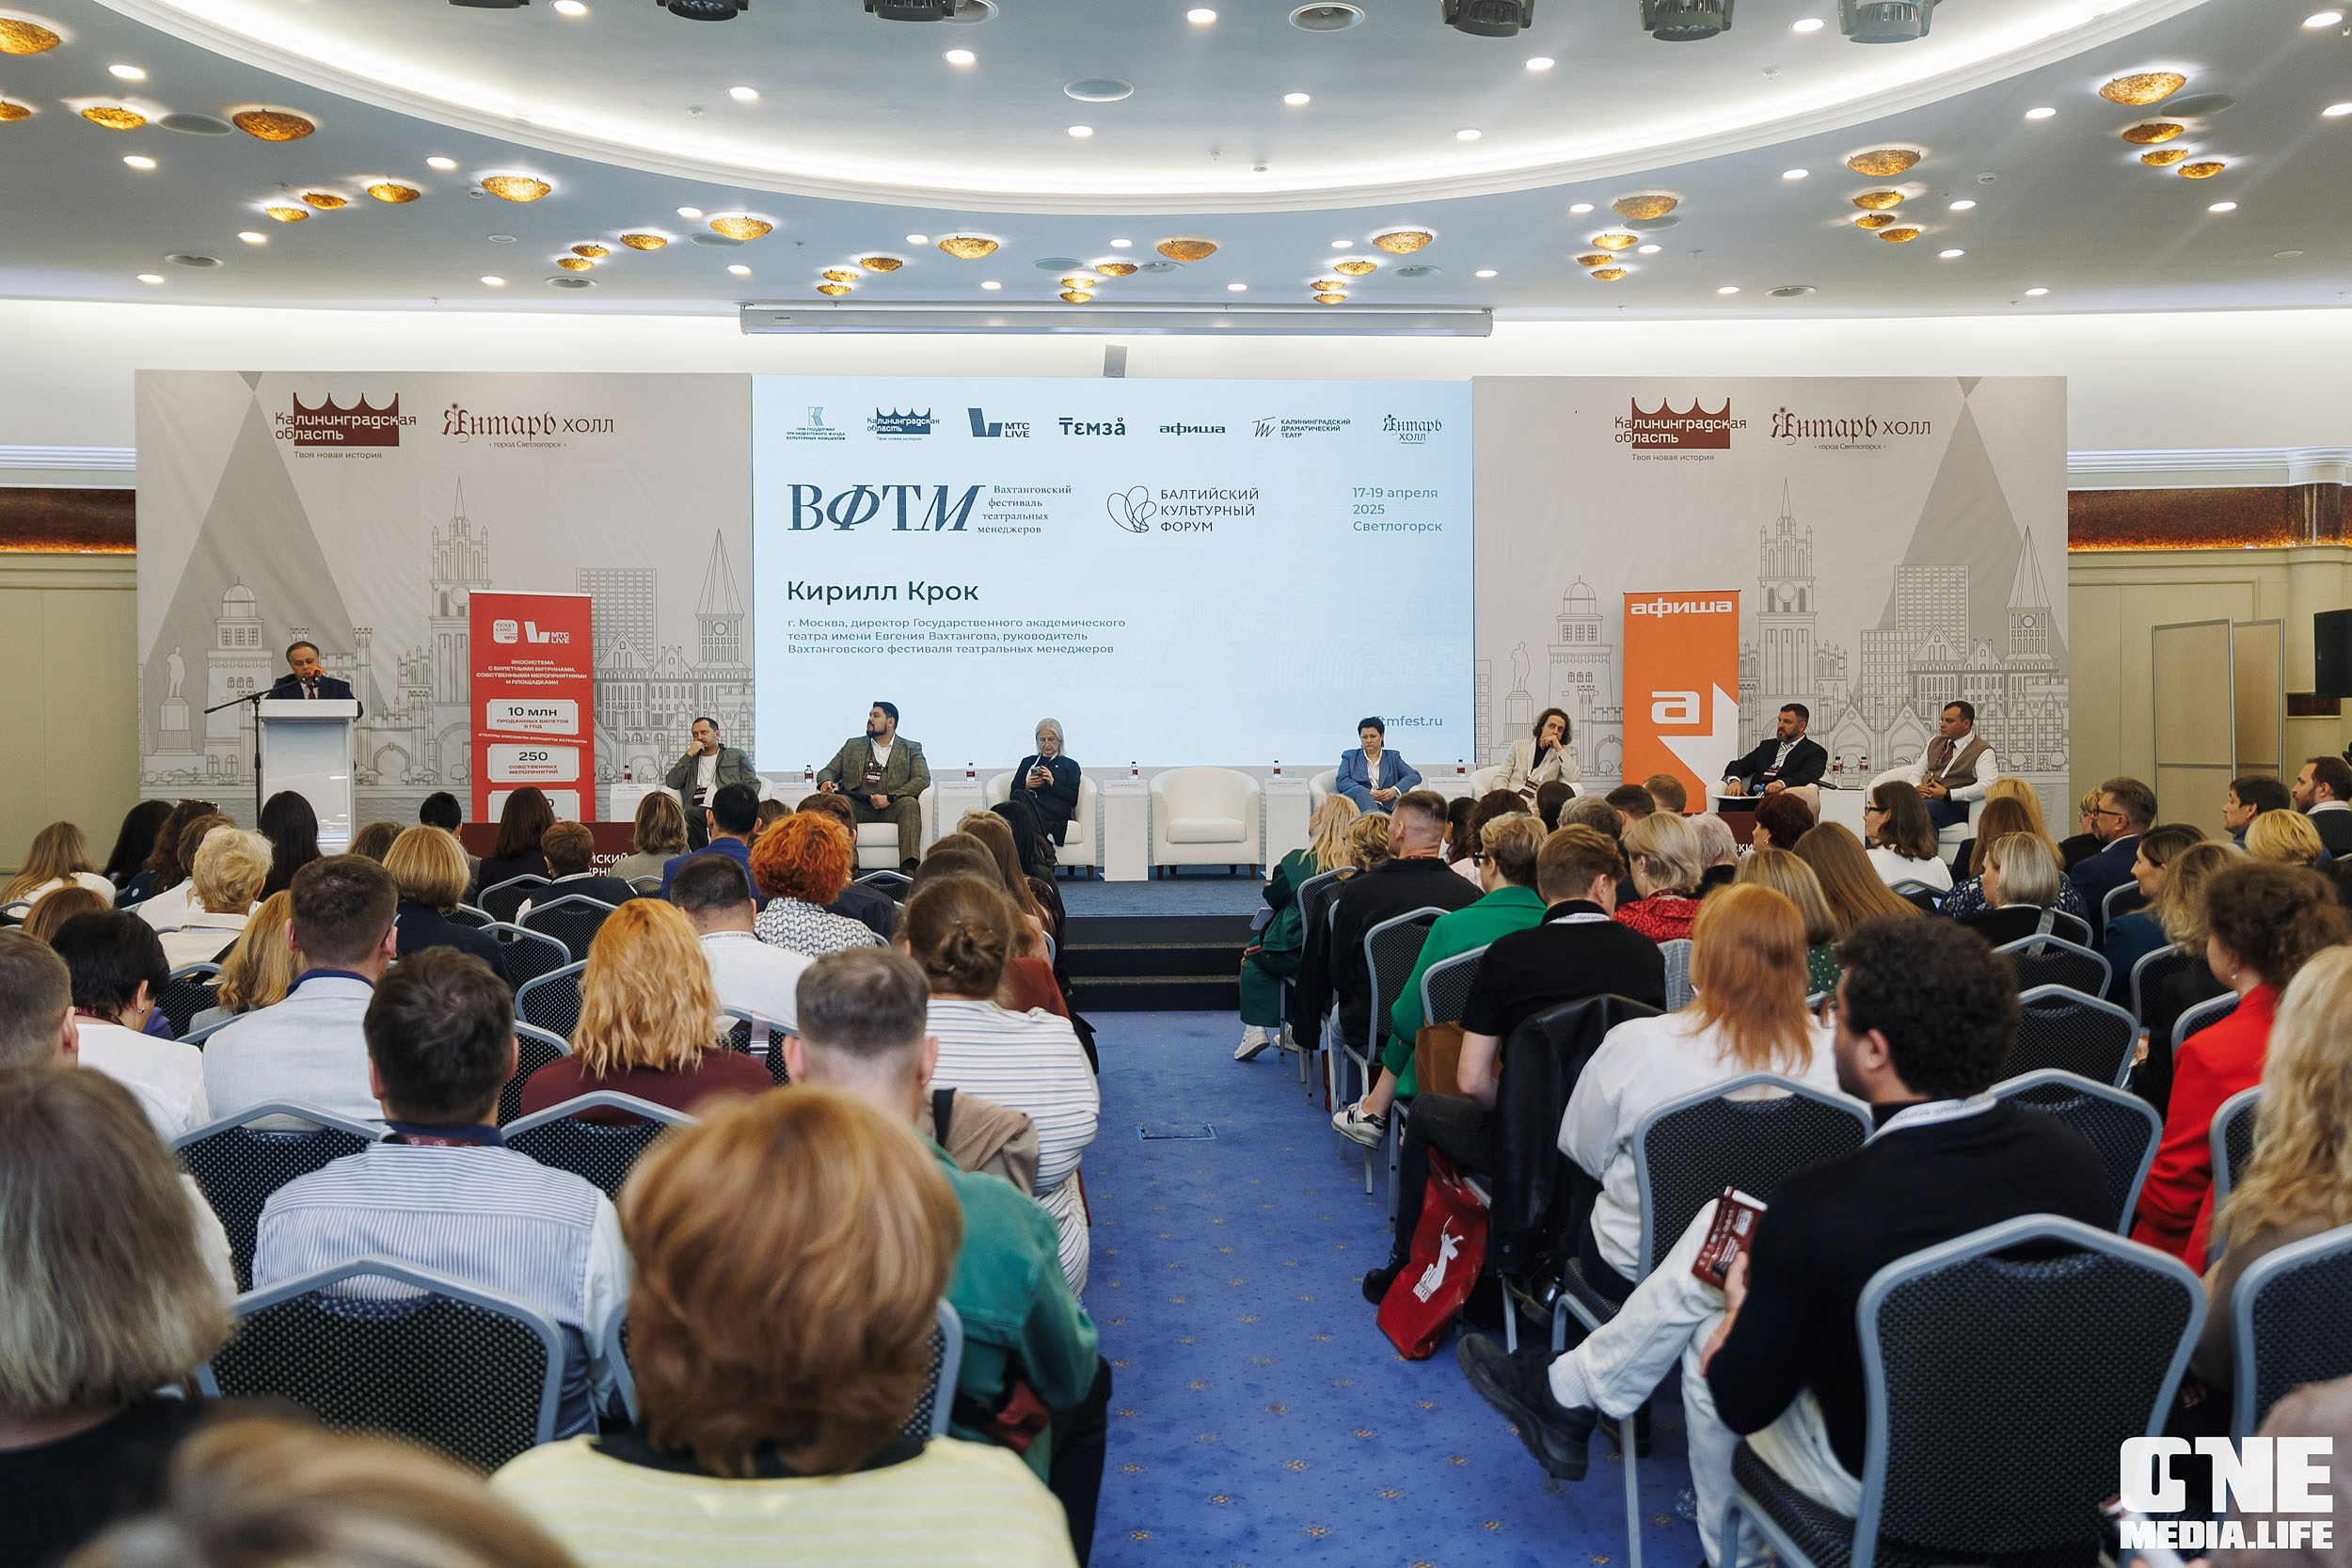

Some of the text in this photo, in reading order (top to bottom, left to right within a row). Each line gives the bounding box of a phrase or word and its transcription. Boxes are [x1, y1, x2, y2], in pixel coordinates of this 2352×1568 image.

[276, 412, 417, 431] Калининградская
[866, 417, 940, 428] Калининградская
[1614, 417, 1747, 433] Калининградская
[276, 426, 344, 441] область
[866, 424, 903, 434] область
[1005, 430, 1030, 438] LIVE
[1159, 421, 1226, 436] афиша
[1614, 430, 1679, 444] область
[493, 440, 563, 450] город Светлогорск
[1840, 442, 1883, 451] Светлогорск
[345, 451, 382, 460] история
[1680, 454, 1715, 463] история
[993, 484, 1073, 495] Вахтанговский
[1160, 486, 1259, 500] БАЛТИЙСКИЙ
[1352, 486, 1438, 501] 17-19 апреля
[787, 484, 986, 532] ВФТМ
[988, 497, 1043, 509] фестиваль
[1160, 503, 1255, 516] КУЛЬТУРНЫЙ
[1352, 503, 1385, 515] 2025
[981, 512, 1049, 521] театральных
[977, 525, 1041, 535] менеджеров
[1160, 520, 1214, 533] ФОРУМ
[1352, 520, 1443, 534] Светлогорск
[787, 579, 979, 605] Кирилл Крок
[1630, 597, 1732, 618] афиша
[787, 617, 1126, 630] г. Москва, директор Государственного академического
[787, 630, 1089, 643] театра имени Евгения Вахтангова, руководитель
[787, 643, 1114, 657] Вахтанговского фестиваля театральных менеджеров
[508, 706, 524, 717] 10
[518, 752, 548, 761] 250
